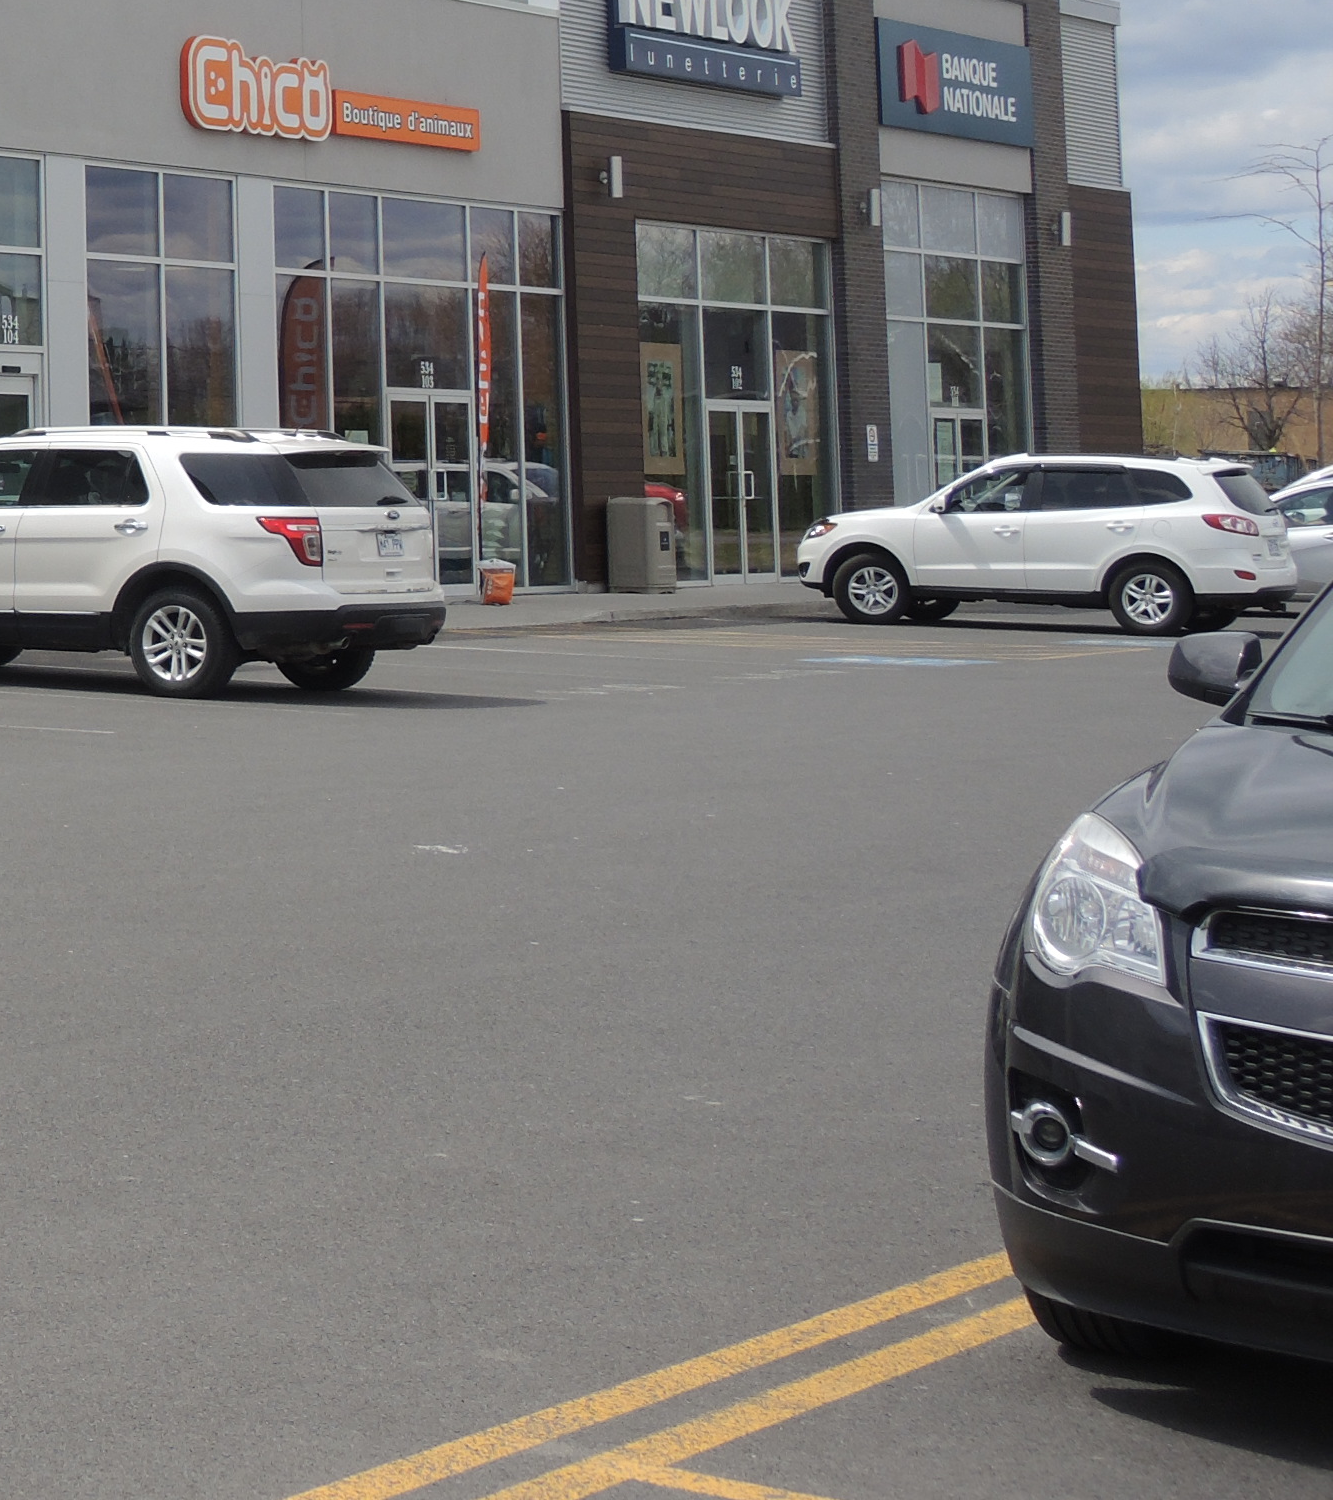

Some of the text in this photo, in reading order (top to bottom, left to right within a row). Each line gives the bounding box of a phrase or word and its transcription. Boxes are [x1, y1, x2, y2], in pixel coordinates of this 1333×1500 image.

[630, 43, 797, 88] lunetterie
[942, 53, 998, 88] BANQUE
[195, 45, 327, 131] Chico
[943, 86, 1017, 122] NATIONALE
[342, 102, 473, 139] Boutique d'animaux
[2, 314, 19, 329] 534
[3, 329, 19, 344] 104
[420, 361, 434, 374] 534
[421, 375, 434, 388] 103
